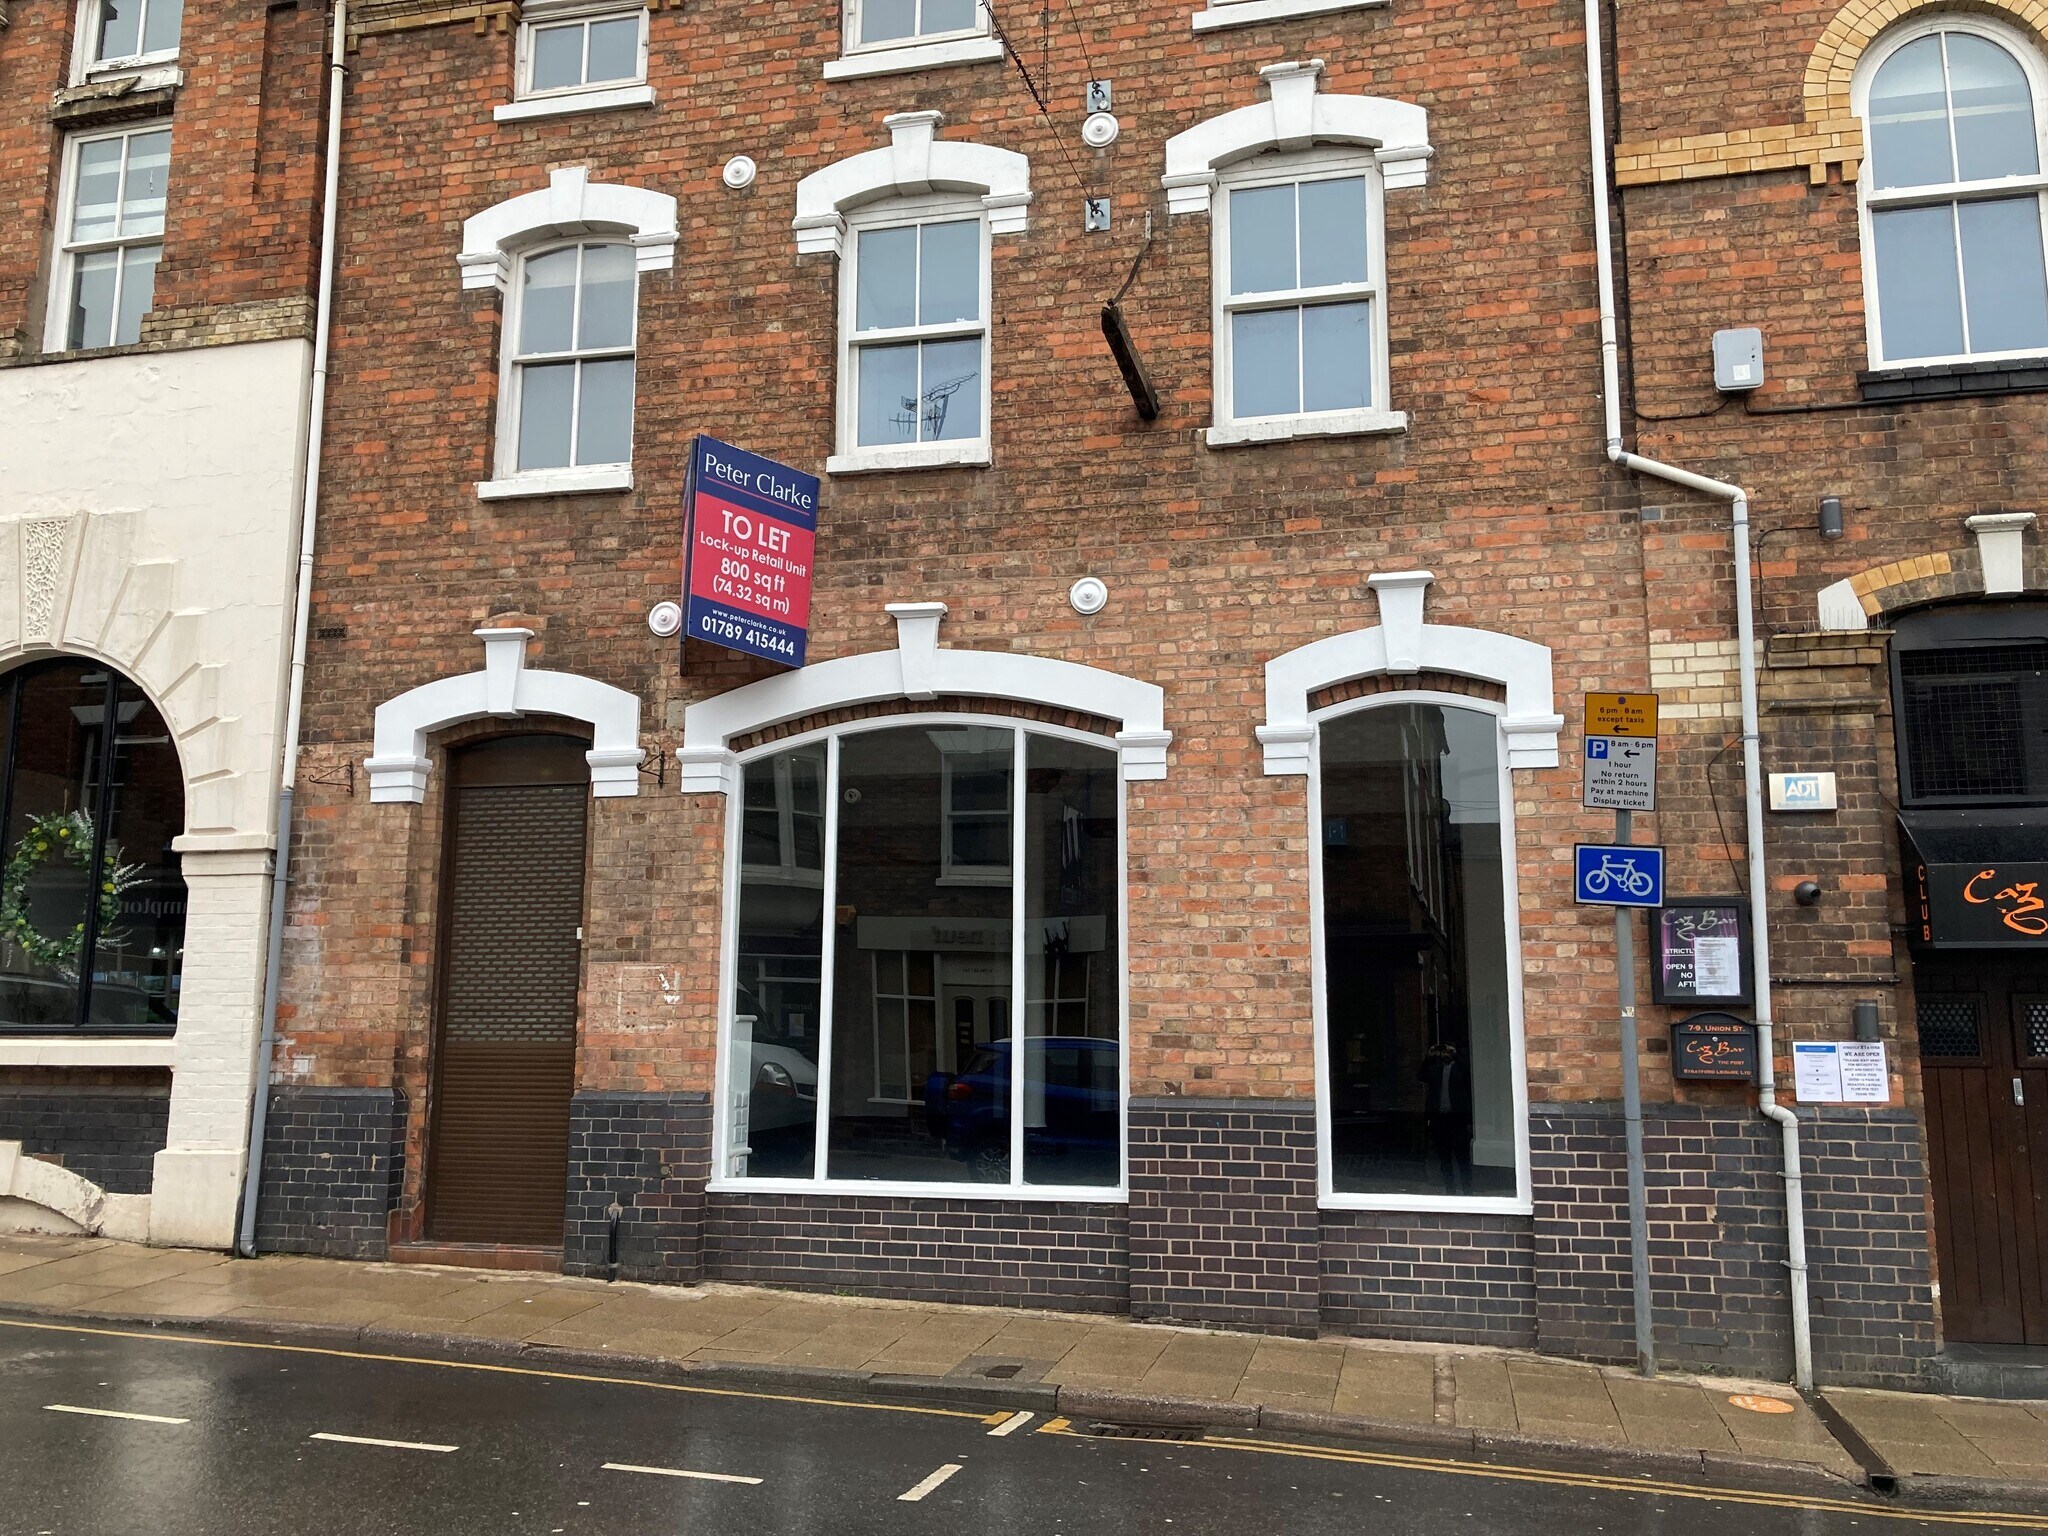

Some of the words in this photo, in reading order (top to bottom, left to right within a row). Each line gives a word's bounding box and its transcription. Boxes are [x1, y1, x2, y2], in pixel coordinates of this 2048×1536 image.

[705, 453, 750, 486] Peter
[757, 473, 811, 508] Clarke
[722, 510, 752, 540] TO
[758, 522, 790, 553] LET
[700, 531, 749, 559] Lock-up
[752, 549, 783, 570] Retail
[785, 560, 806, 577] Unit
[720, 557, 749, 581] 800
[754, 572, 771, 592] sq
[774, 574, 785, 592] ft
[713, 575, 752, 601] (74.32
[755, 593, 770, 610] sq
[773, 597, 790, 614] m)
[712, 608, 786, 635] www.peterclarke.co.uk
[702, 616, 742, 640] 01789
[745, 629, 794, 656] 415444
[1592, 741, 1606, 757] P
[1590, 787, 1604, 795] Pay
[1593, 796, 1621, 806] Display
[1623, 799, 1645, 807] ticket
[1786, 780, 1818, 798] ADT
[1917, 865, 1931, 941] CLUB
[1697, 909, 1737, 931] Bar
[1680, 971, 1693, 979] NO
[1714, 1041, 1745, 1056] Bar
